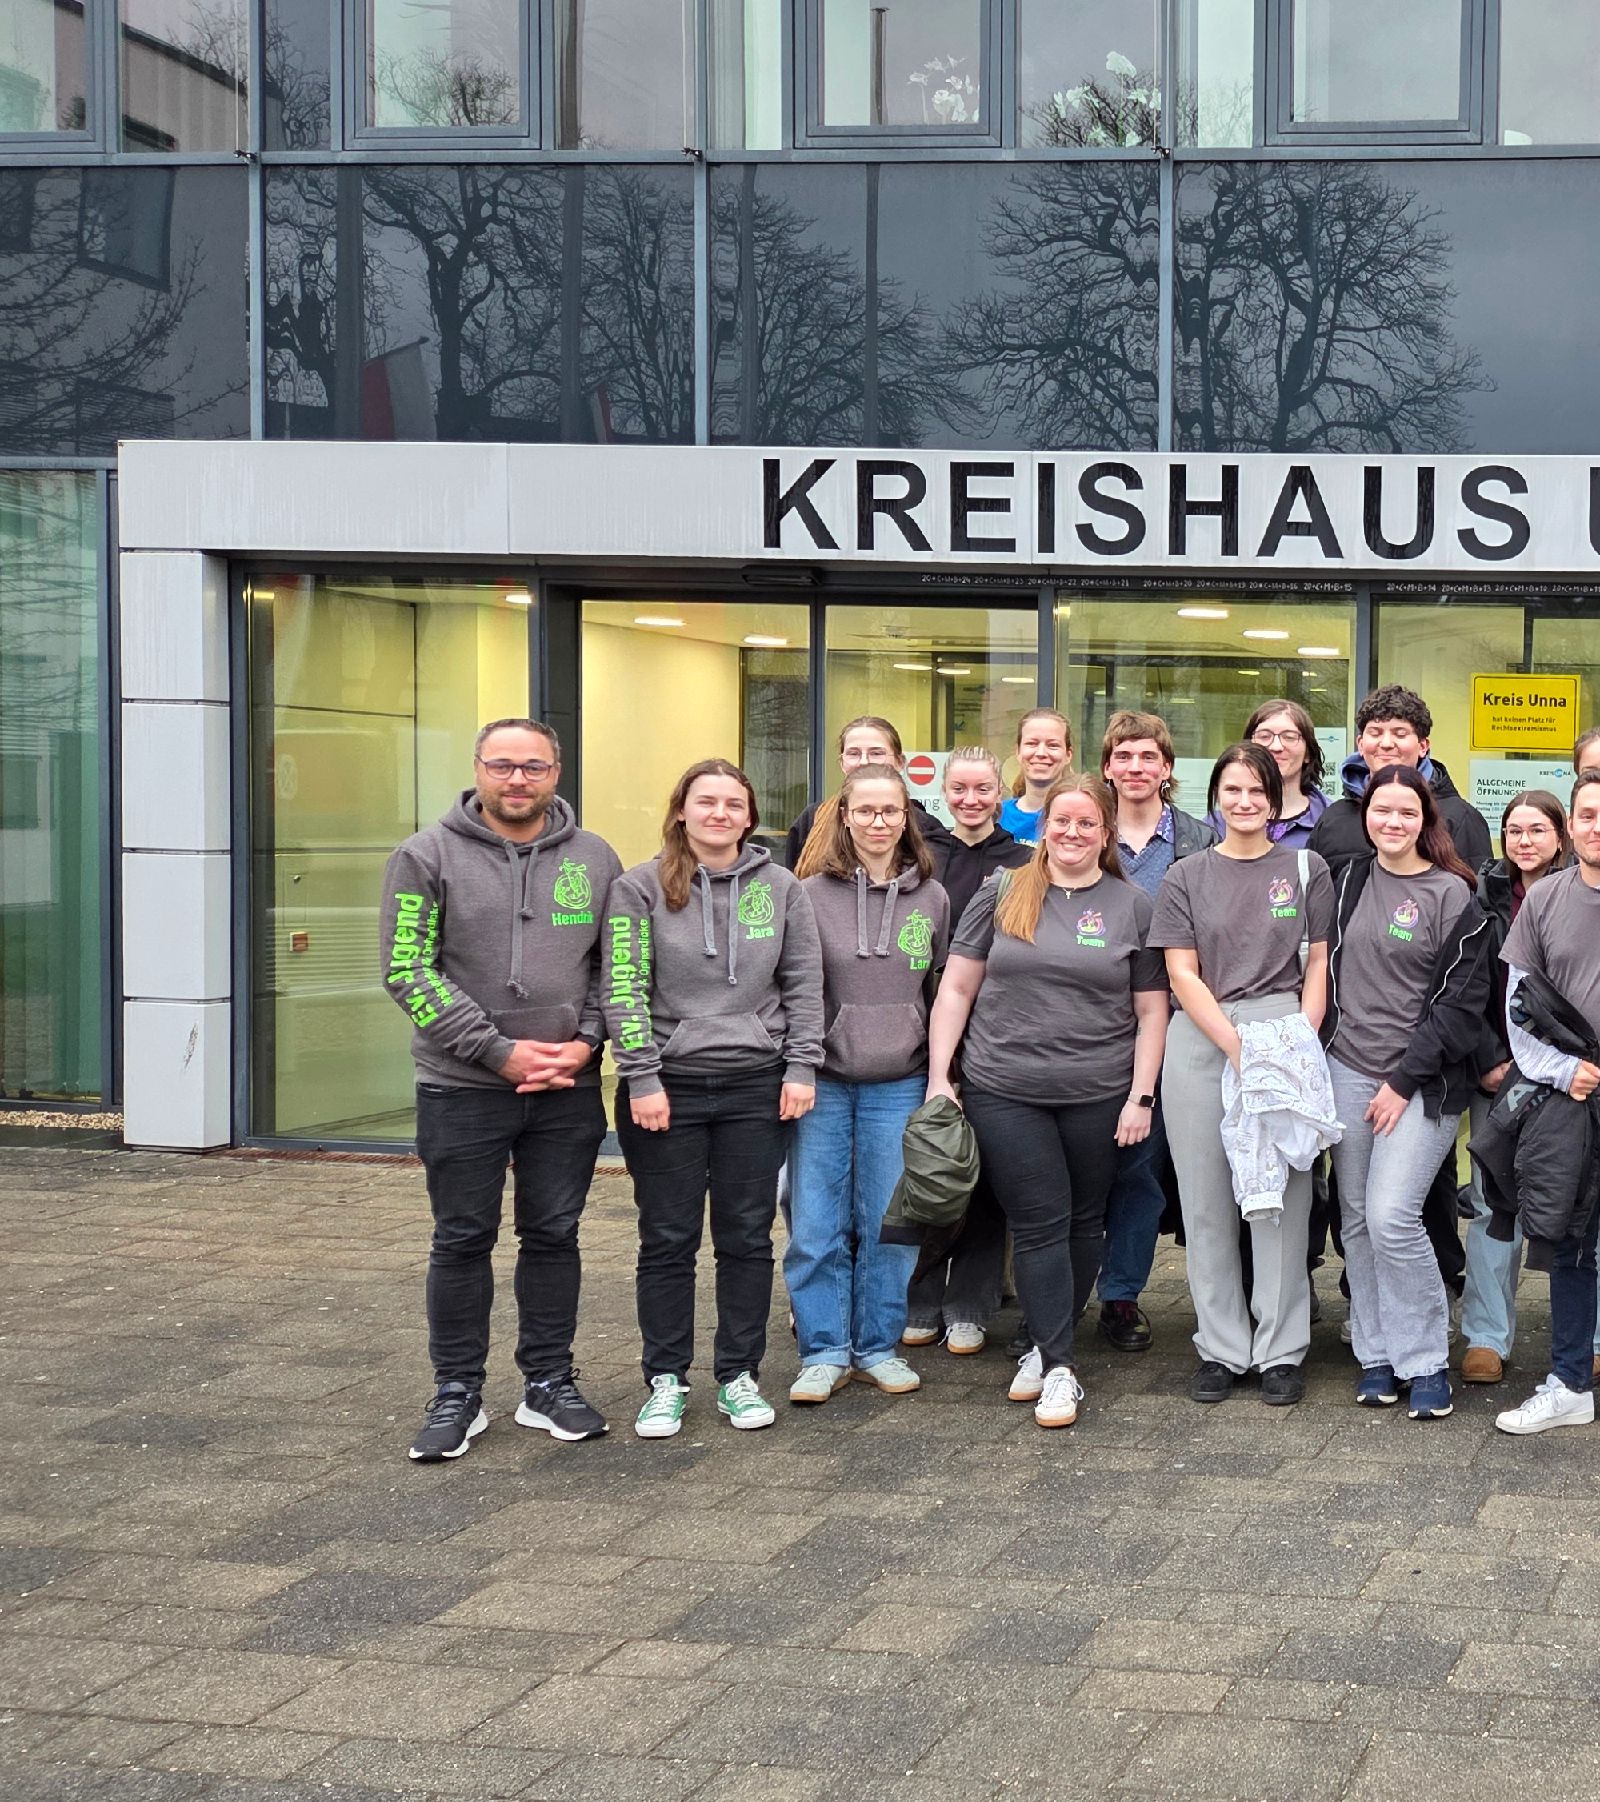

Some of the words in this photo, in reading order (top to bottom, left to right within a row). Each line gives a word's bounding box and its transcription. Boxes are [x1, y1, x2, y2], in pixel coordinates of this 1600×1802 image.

[763, 459, 1531, 562] KREISHAUS
[1483, 692, 1523, 706] Kreis
[1528, 694, 1567, 707] Unna
[1476, 778, 1526, 788] ALLGEMEINE
[1270, 907, 1297, 919] Team
[746, 926, 775, 940] Jara
[1387, 922, 1413, 942] Team
[1076, 934, 1106, 948] Team
[609, 916, 638, 1009] Jugend
[910, 957, 931, 970] Lar
[619, 1014, 644, 1050] Ev.
